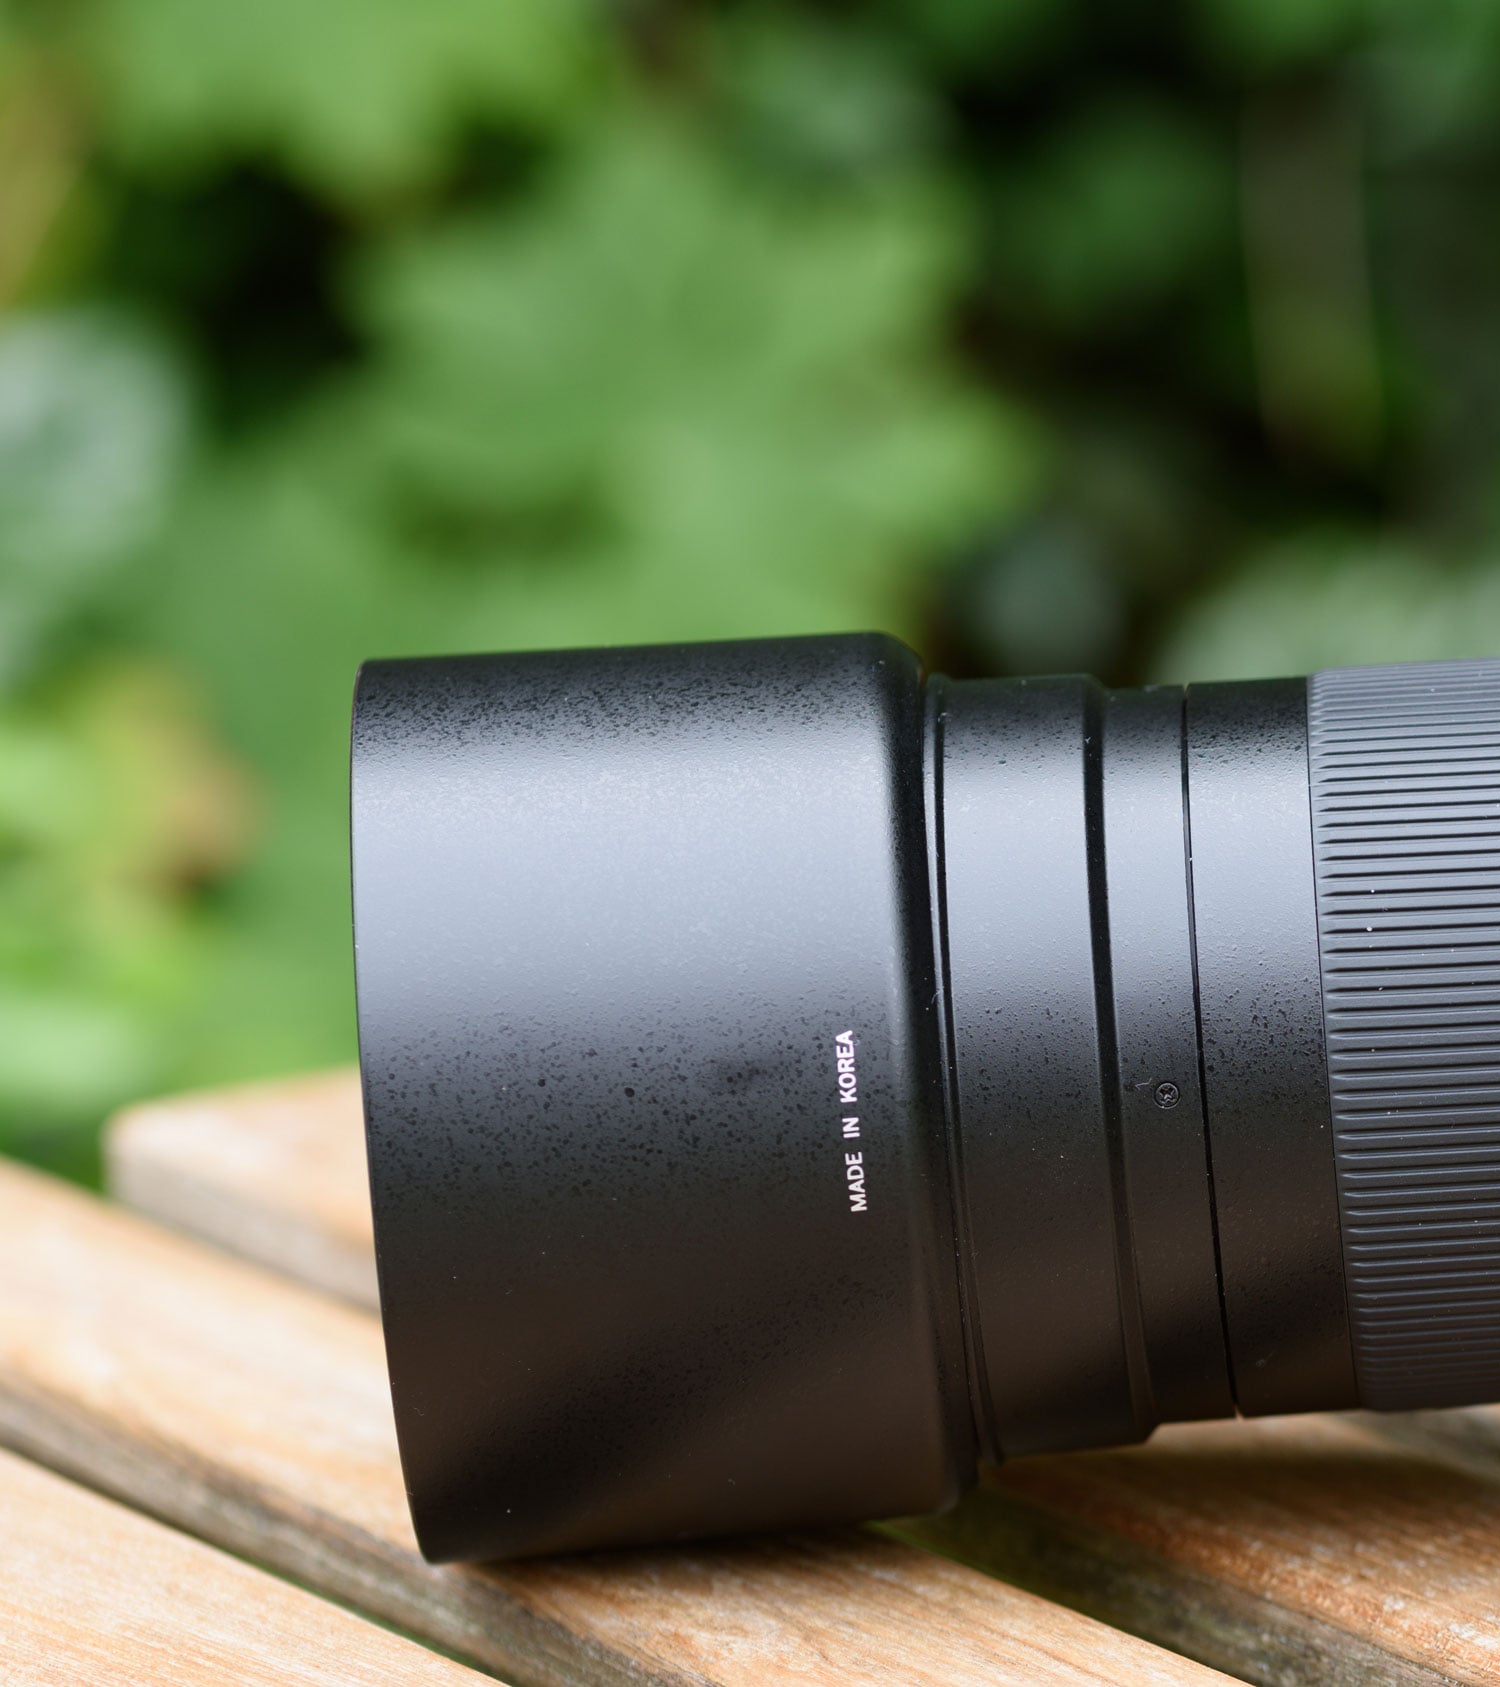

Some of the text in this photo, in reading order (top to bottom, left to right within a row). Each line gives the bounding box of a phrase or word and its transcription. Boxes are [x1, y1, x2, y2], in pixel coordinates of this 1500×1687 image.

[835, 1029, 868, 1212] MADE IN KOREA
